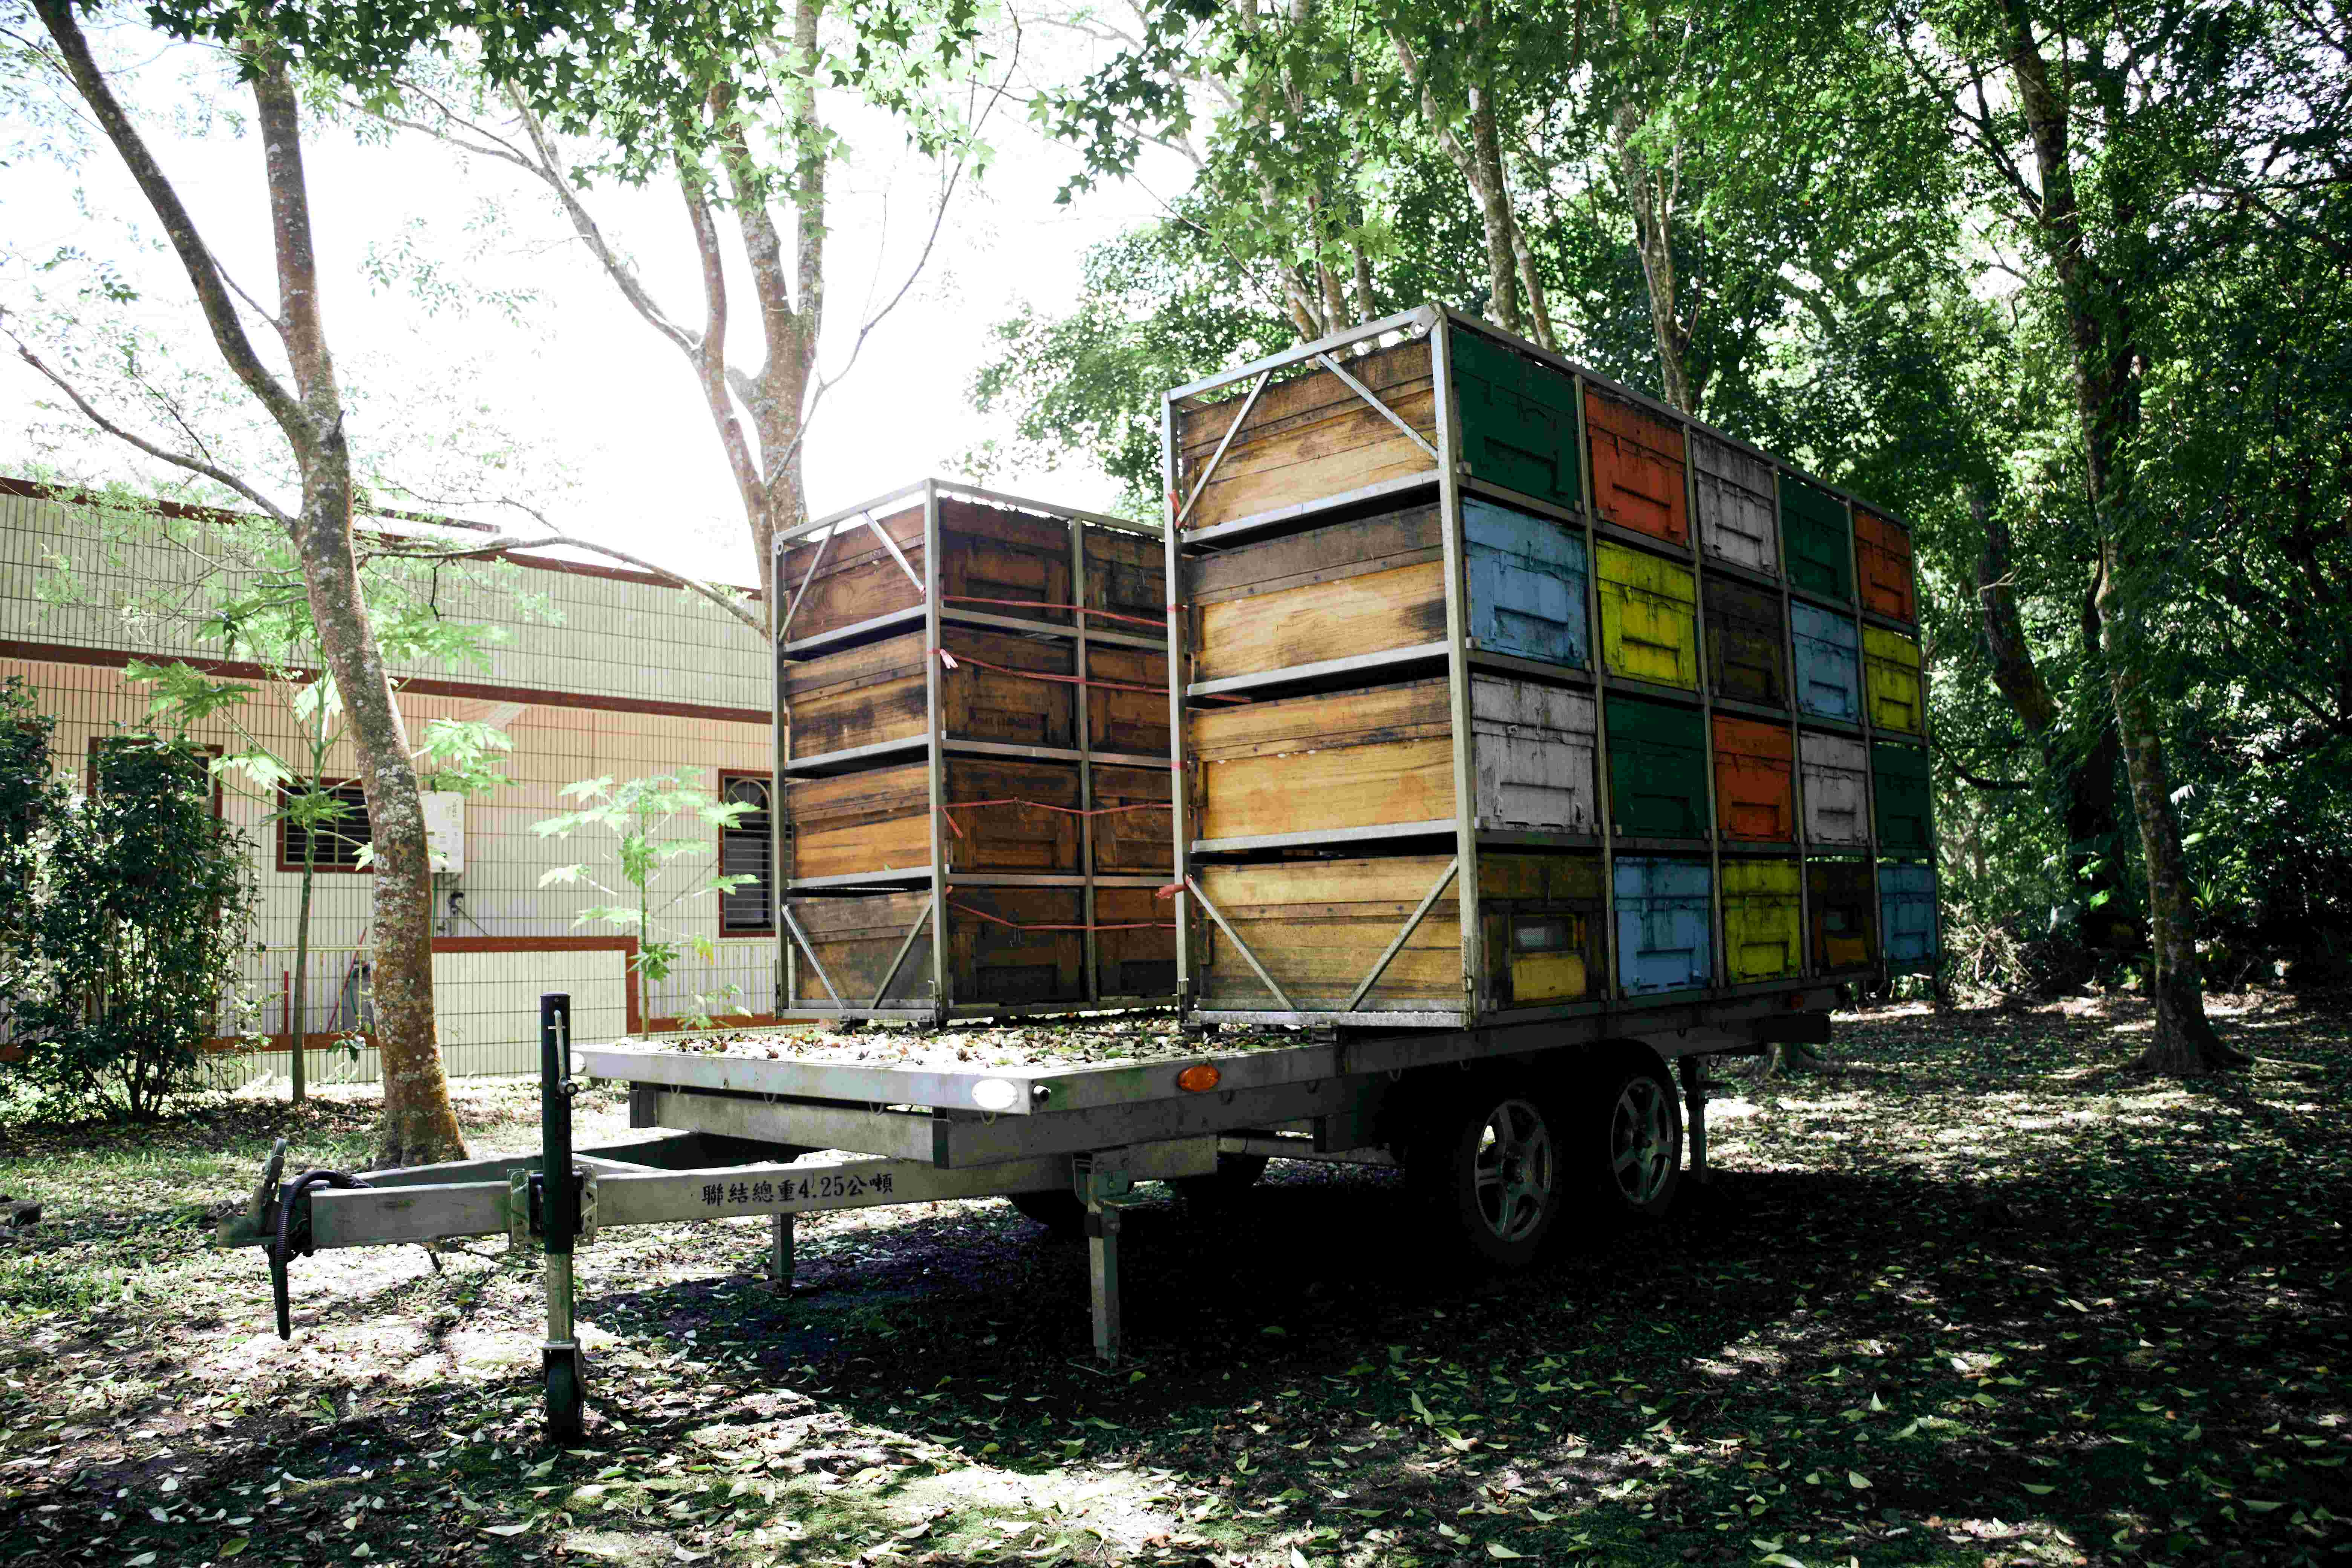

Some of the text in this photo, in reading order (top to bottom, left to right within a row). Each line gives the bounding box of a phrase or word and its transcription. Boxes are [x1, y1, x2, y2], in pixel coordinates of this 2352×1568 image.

[701, 1173, 893, 1207] 聯結總重4.25公噸
